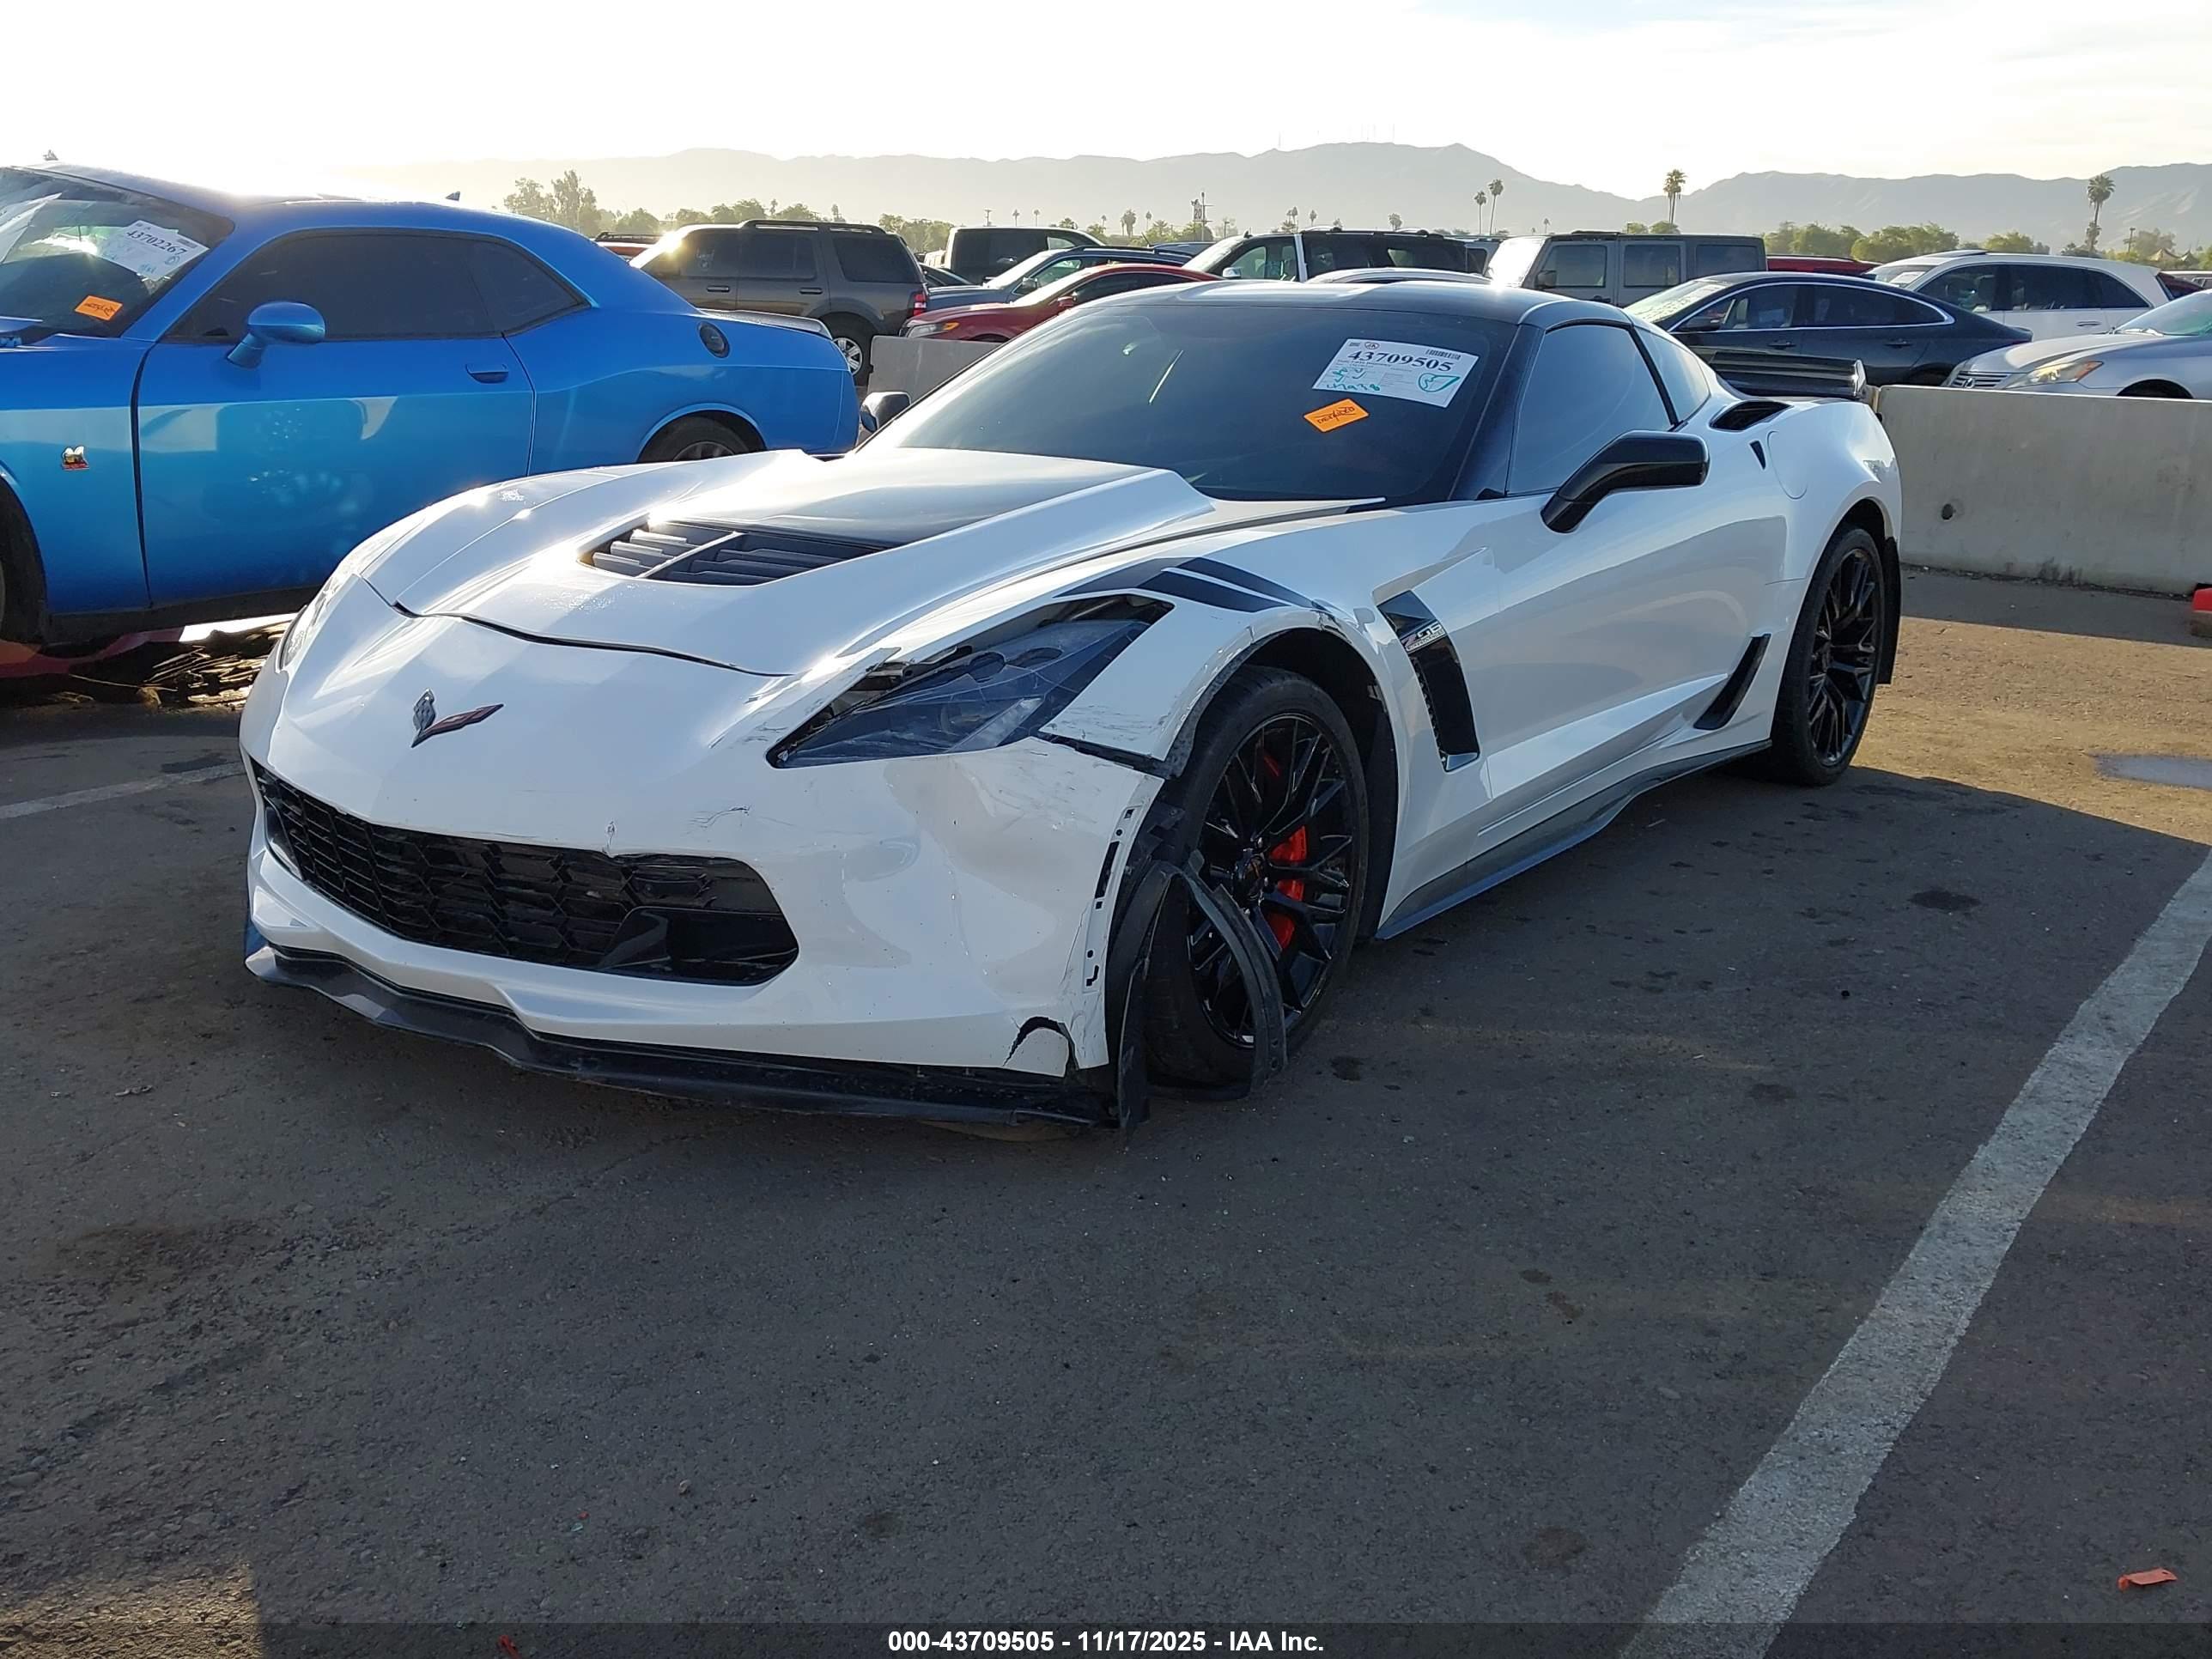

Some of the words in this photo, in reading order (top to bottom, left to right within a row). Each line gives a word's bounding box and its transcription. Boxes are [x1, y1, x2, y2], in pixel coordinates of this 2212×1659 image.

[1194, 208, 1202, 220] 20
[126, 230, 188, 255] 43702267
[1347, 350, 1455, 372] 43709505
